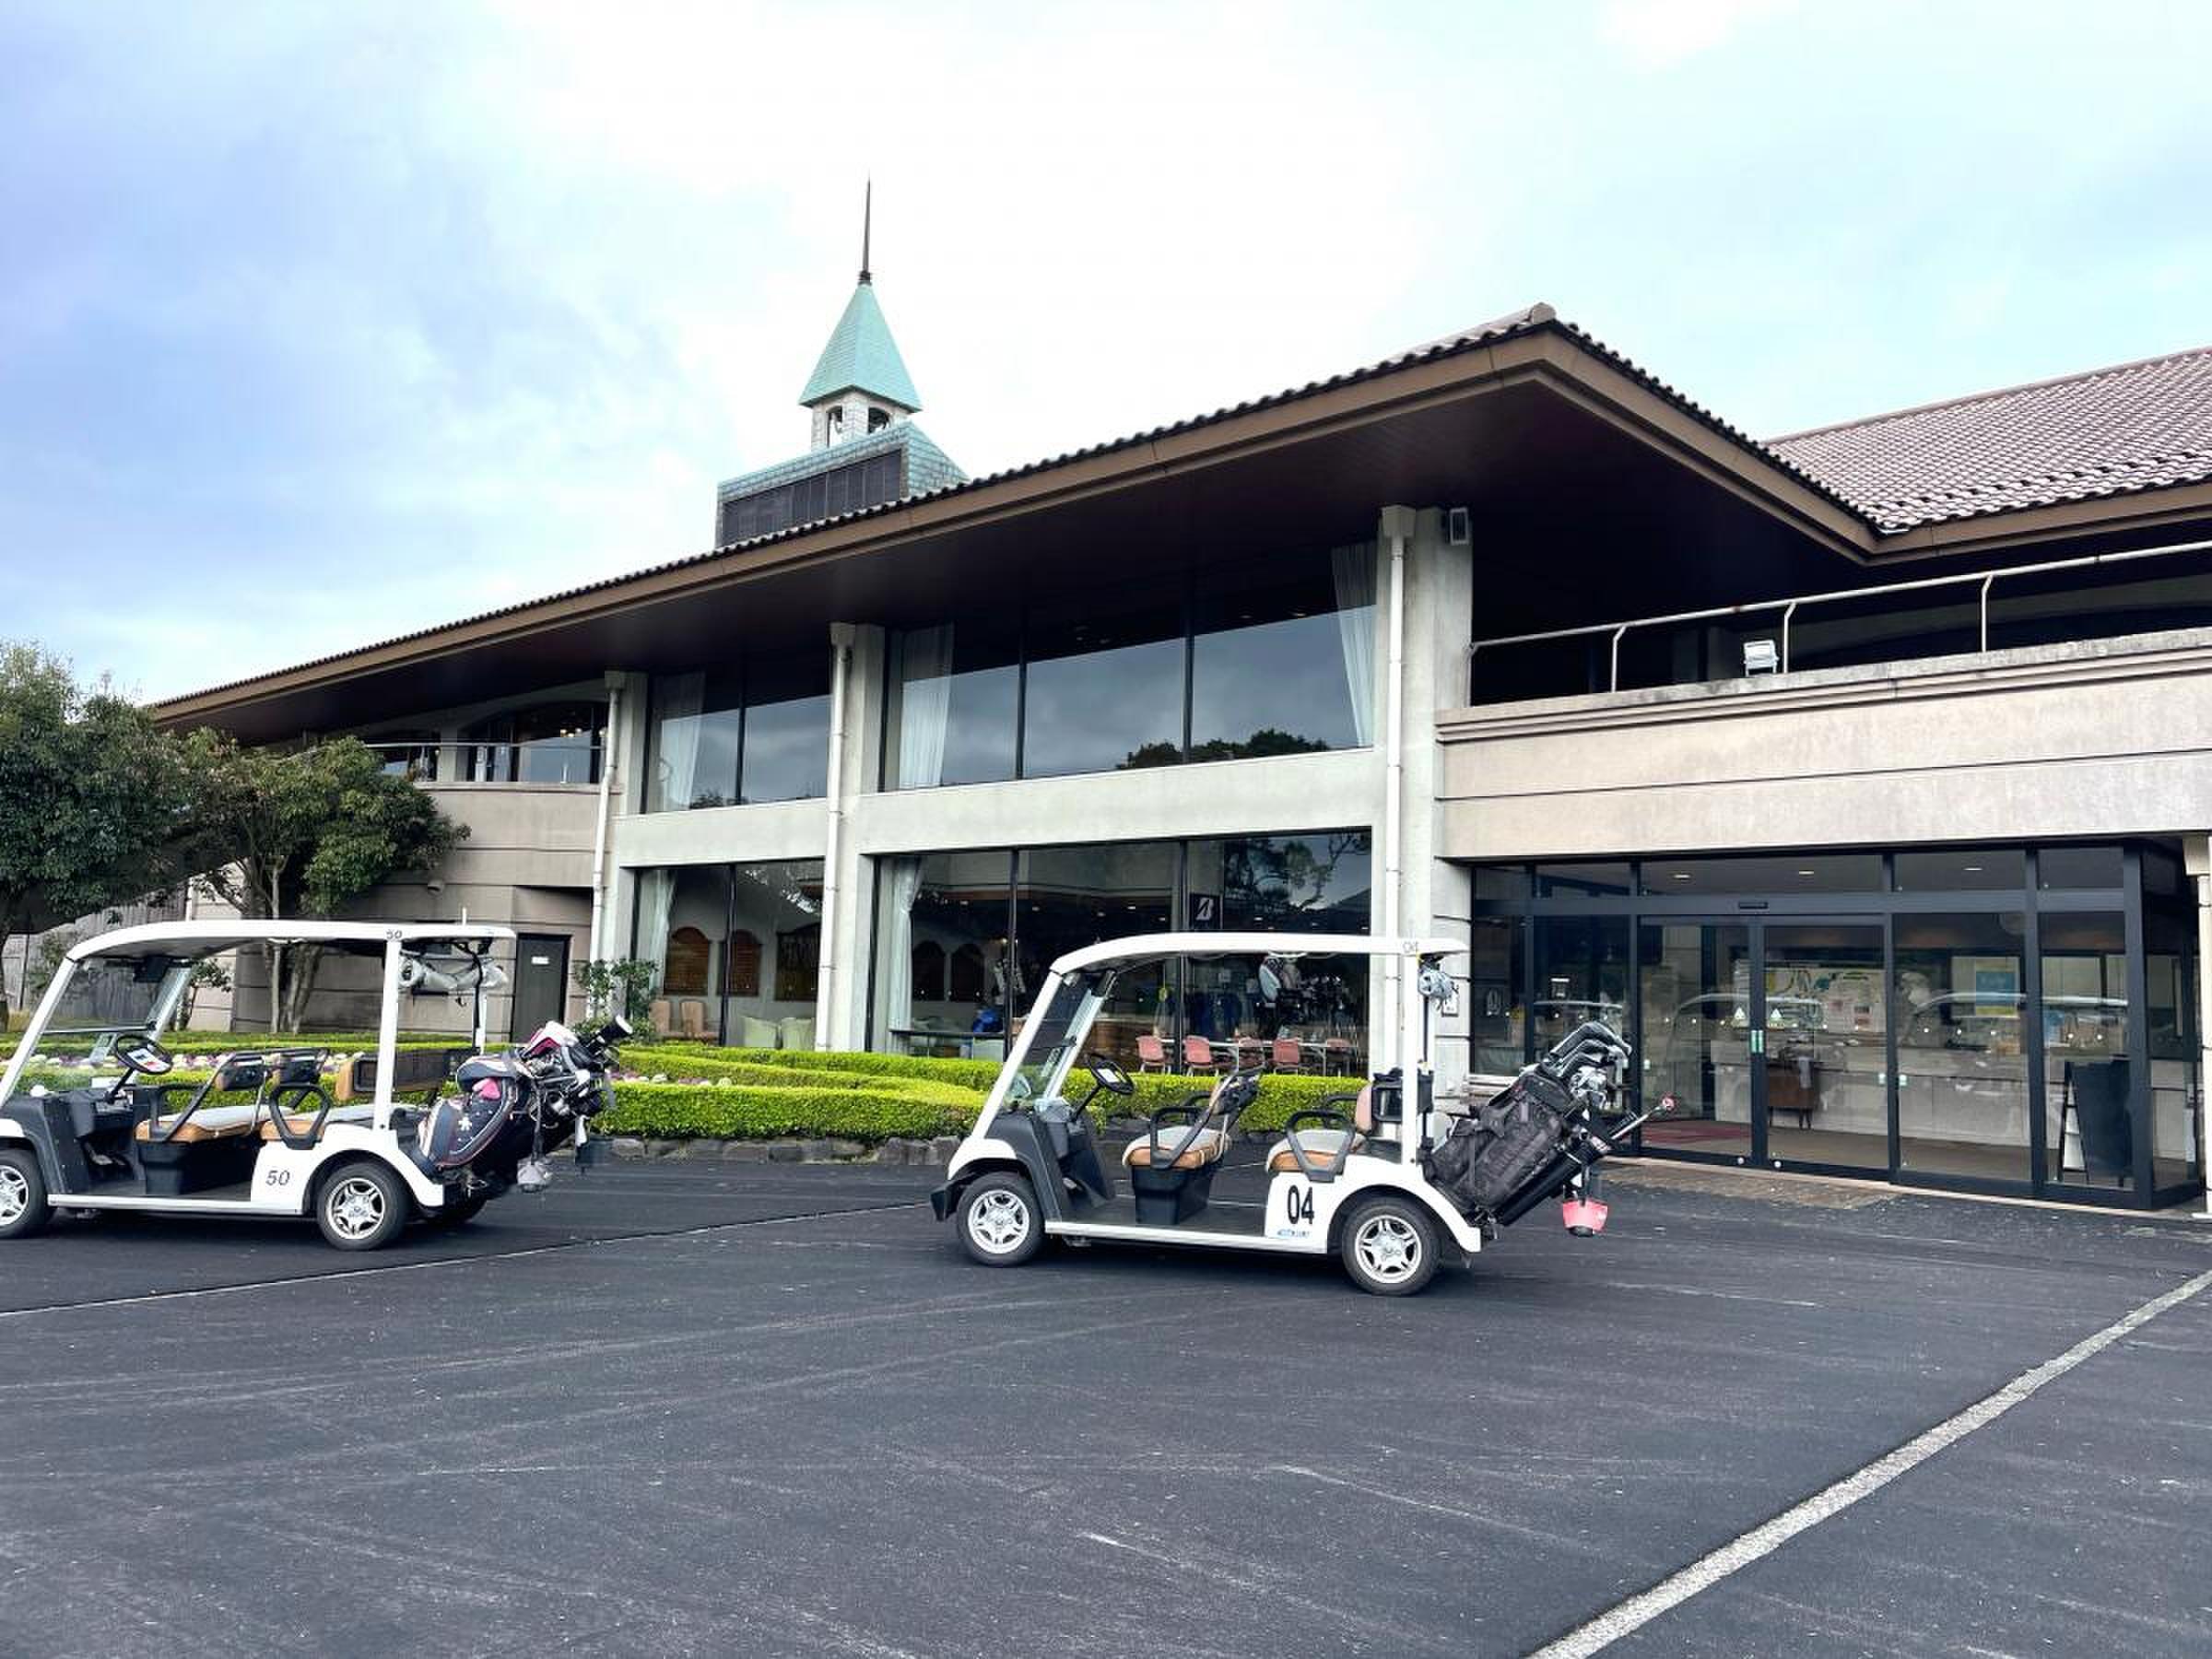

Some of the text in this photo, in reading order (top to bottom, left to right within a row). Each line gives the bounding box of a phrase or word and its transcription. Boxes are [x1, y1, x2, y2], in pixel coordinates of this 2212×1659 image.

[386, 928, 403, 940] 50
[265, 1170, 290, 1186] 50
[1288, 1184, 1314, 1225] 04
